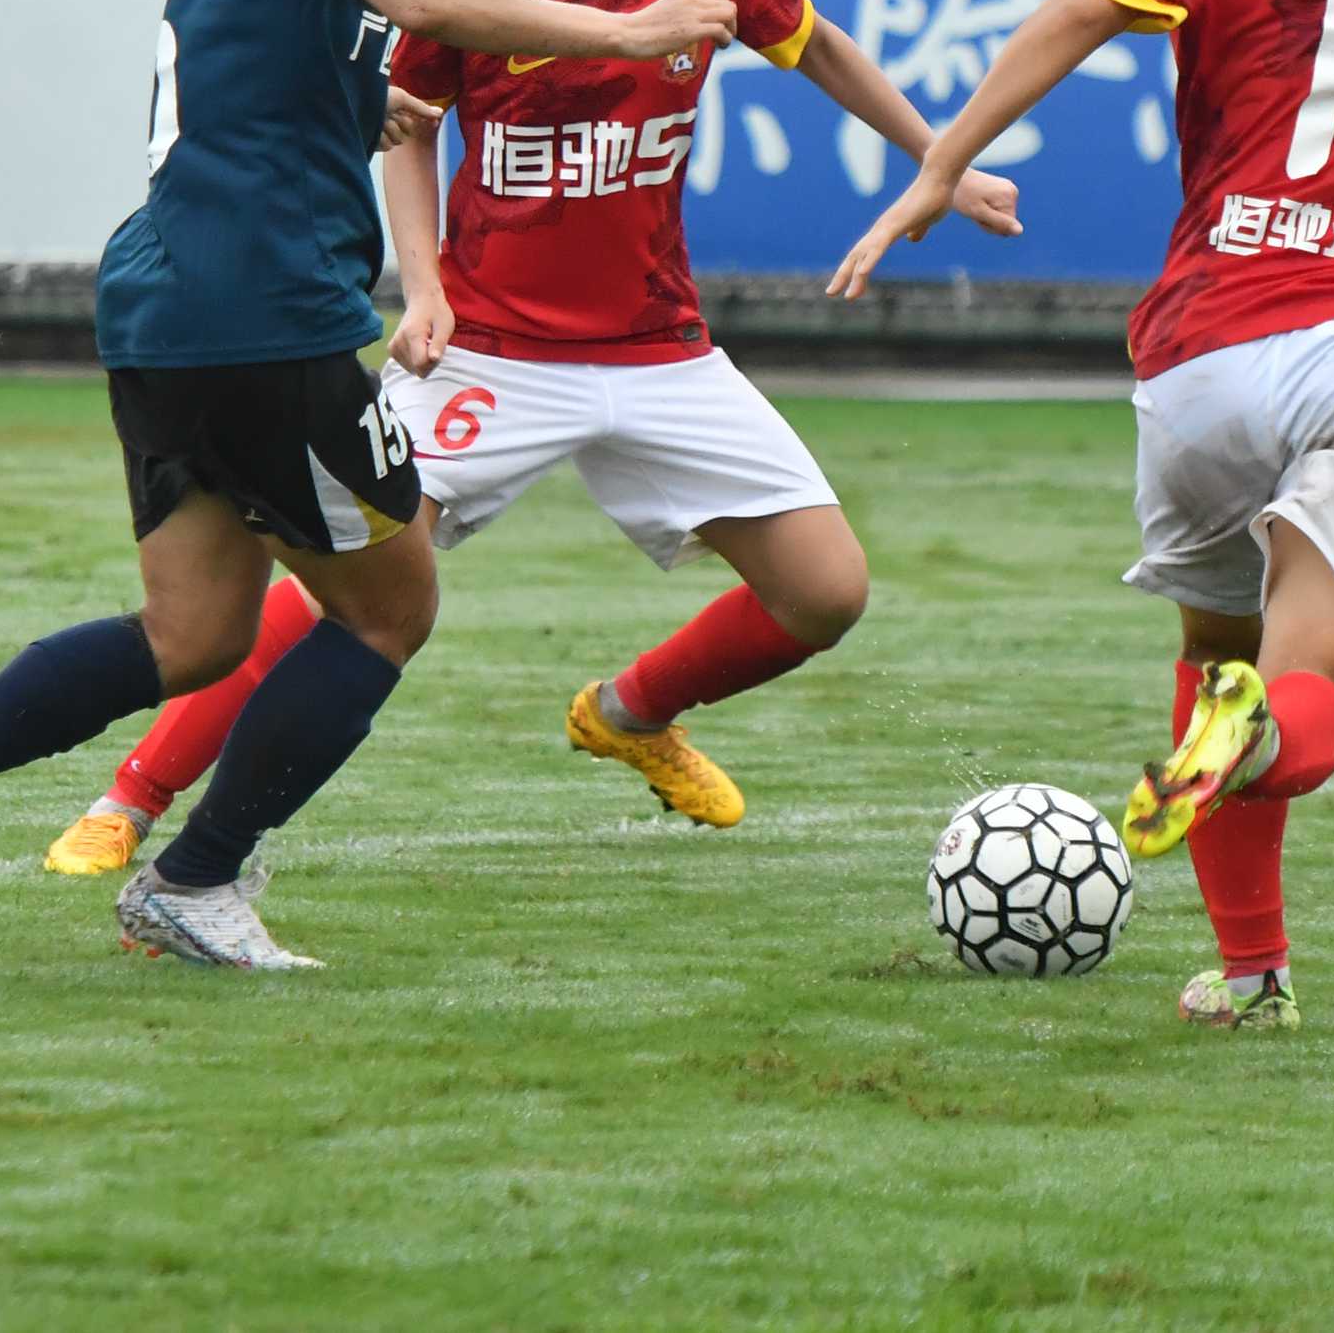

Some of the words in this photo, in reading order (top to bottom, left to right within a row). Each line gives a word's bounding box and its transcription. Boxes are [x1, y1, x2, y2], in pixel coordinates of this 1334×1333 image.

[481, 107, 698, 198] 恒驰5
[358, 387, 409, 481] 15
[433, 386, 497, 451] 6
